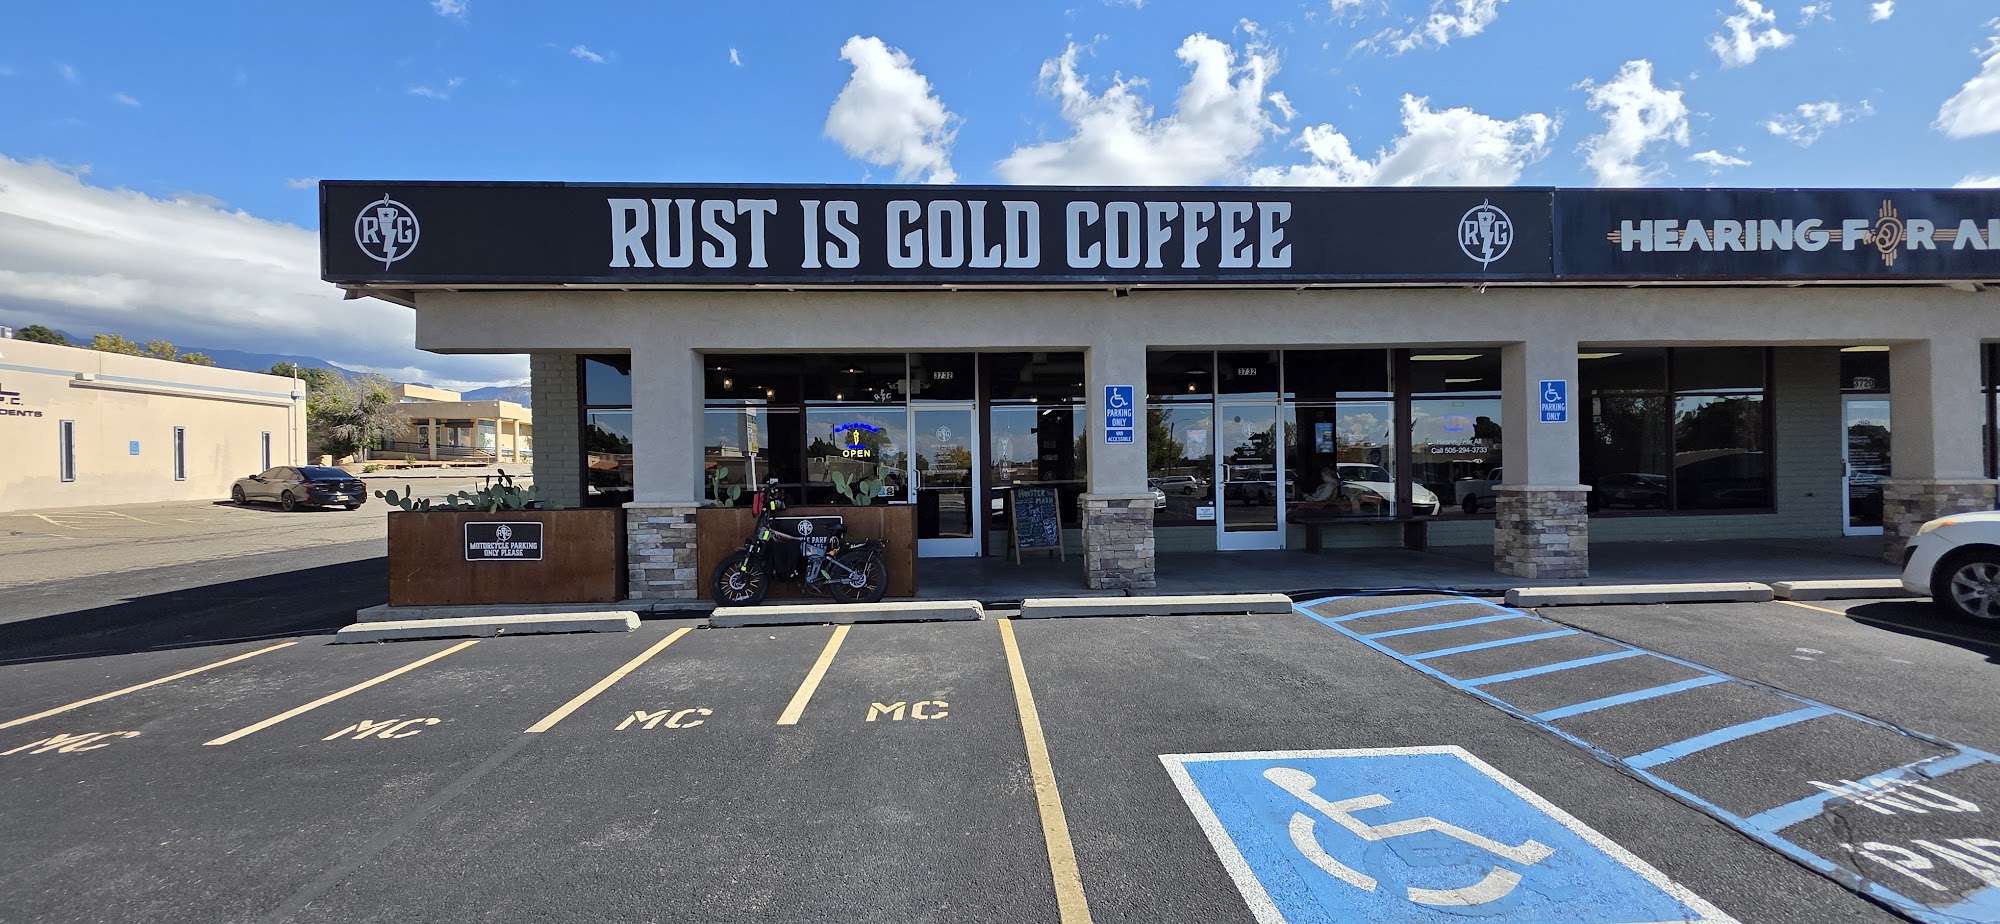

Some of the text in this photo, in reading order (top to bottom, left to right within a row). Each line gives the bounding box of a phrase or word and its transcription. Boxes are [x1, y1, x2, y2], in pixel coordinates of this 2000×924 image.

[607, 198, 1292, 269] RUST IS GOLD COFFEE
[1620, 218, 1830, 252] HEARING
[1853, 378, 1875, 388] 3720
[1541, 402, 1566, 411] PARKING
[1106, 408, 1132, 417] PARKING
[1546, 412, 1561, 421] ONLY
[1111, 418, 1127, 427] ONLY
[842, 449, 871, 458] OPEN
[1444, 446, 1488, 454] 505-294-3733
[469, 542, 538, 550] MOTORCYCLE PARKING
[483, 549, 524, 557] ONLY PLEASE
[866, 700, 949, 722] MC
[614, 708, 714, 731] MC
[321, 717, 442, 741] MC
[0, 730, 141, 757] MC
[1806, 777, 1982, 816] NO
